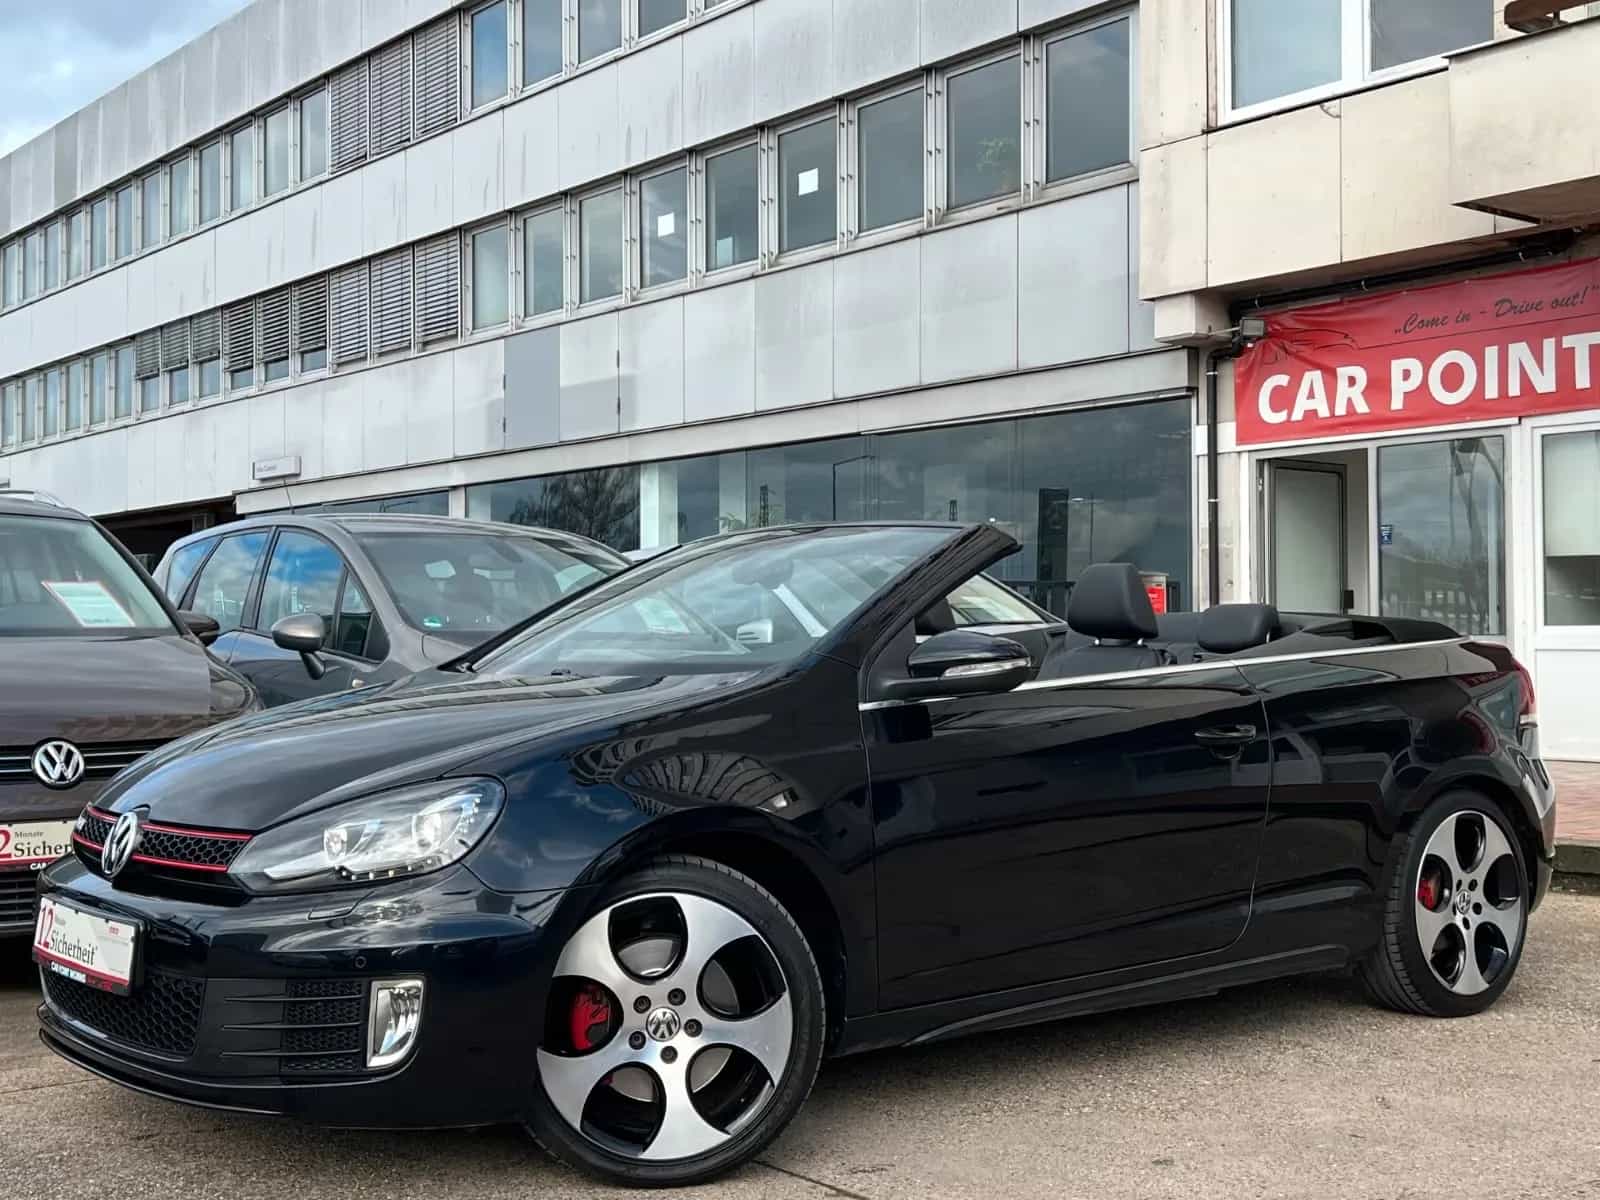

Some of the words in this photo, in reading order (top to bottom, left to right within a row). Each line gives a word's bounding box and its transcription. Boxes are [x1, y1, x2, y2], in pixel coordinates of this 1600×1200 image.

[1455, 310, 1471, 324] in
[1494, 297, 1544, 318] Drive
[1257, 365, 1370, 424] CAR
[1390, 332, 1600, 410] POINT
